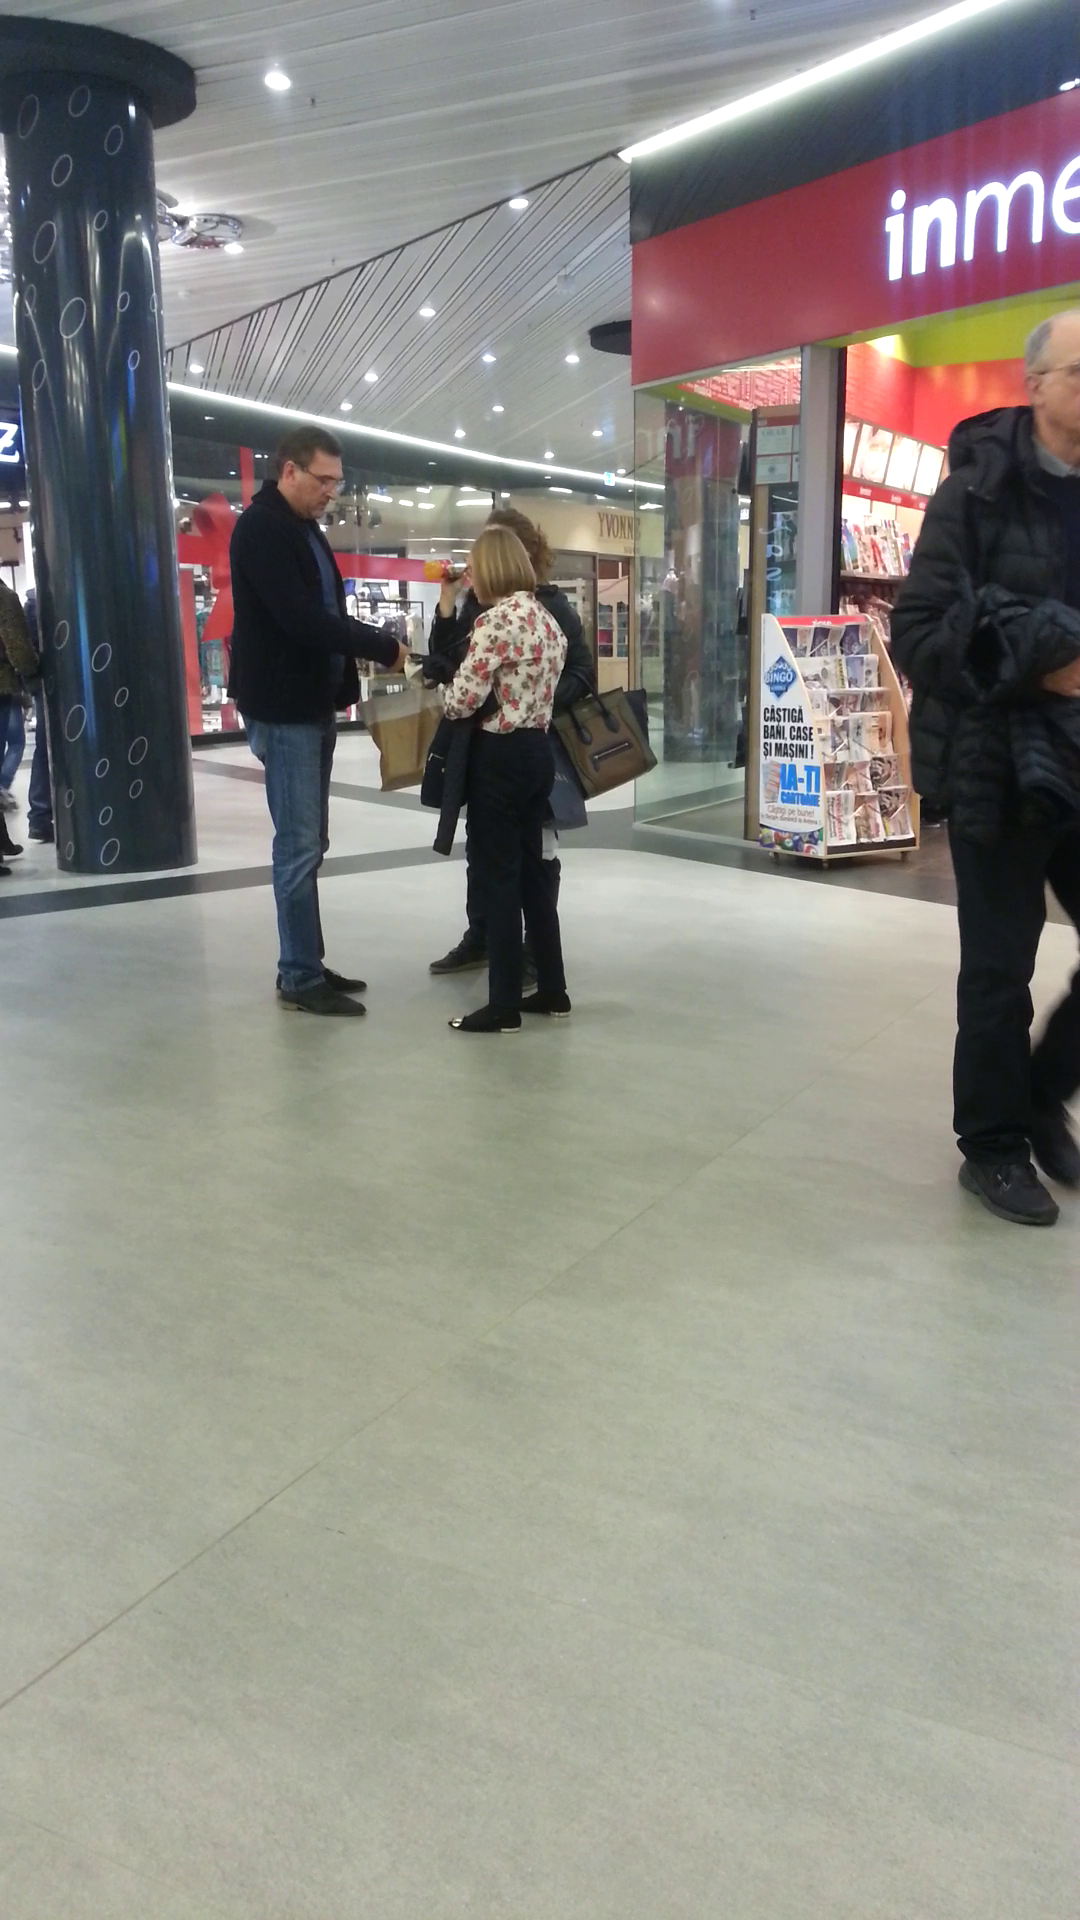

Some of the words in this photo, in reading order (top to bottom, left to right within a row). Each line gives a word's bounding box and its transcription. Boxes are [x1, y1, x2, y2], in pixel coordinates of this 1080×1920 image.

[885, 155, 1080, 281] inme
[764, 671, 793, 684] BINGO
[789, 726, 814, 742] CASE
